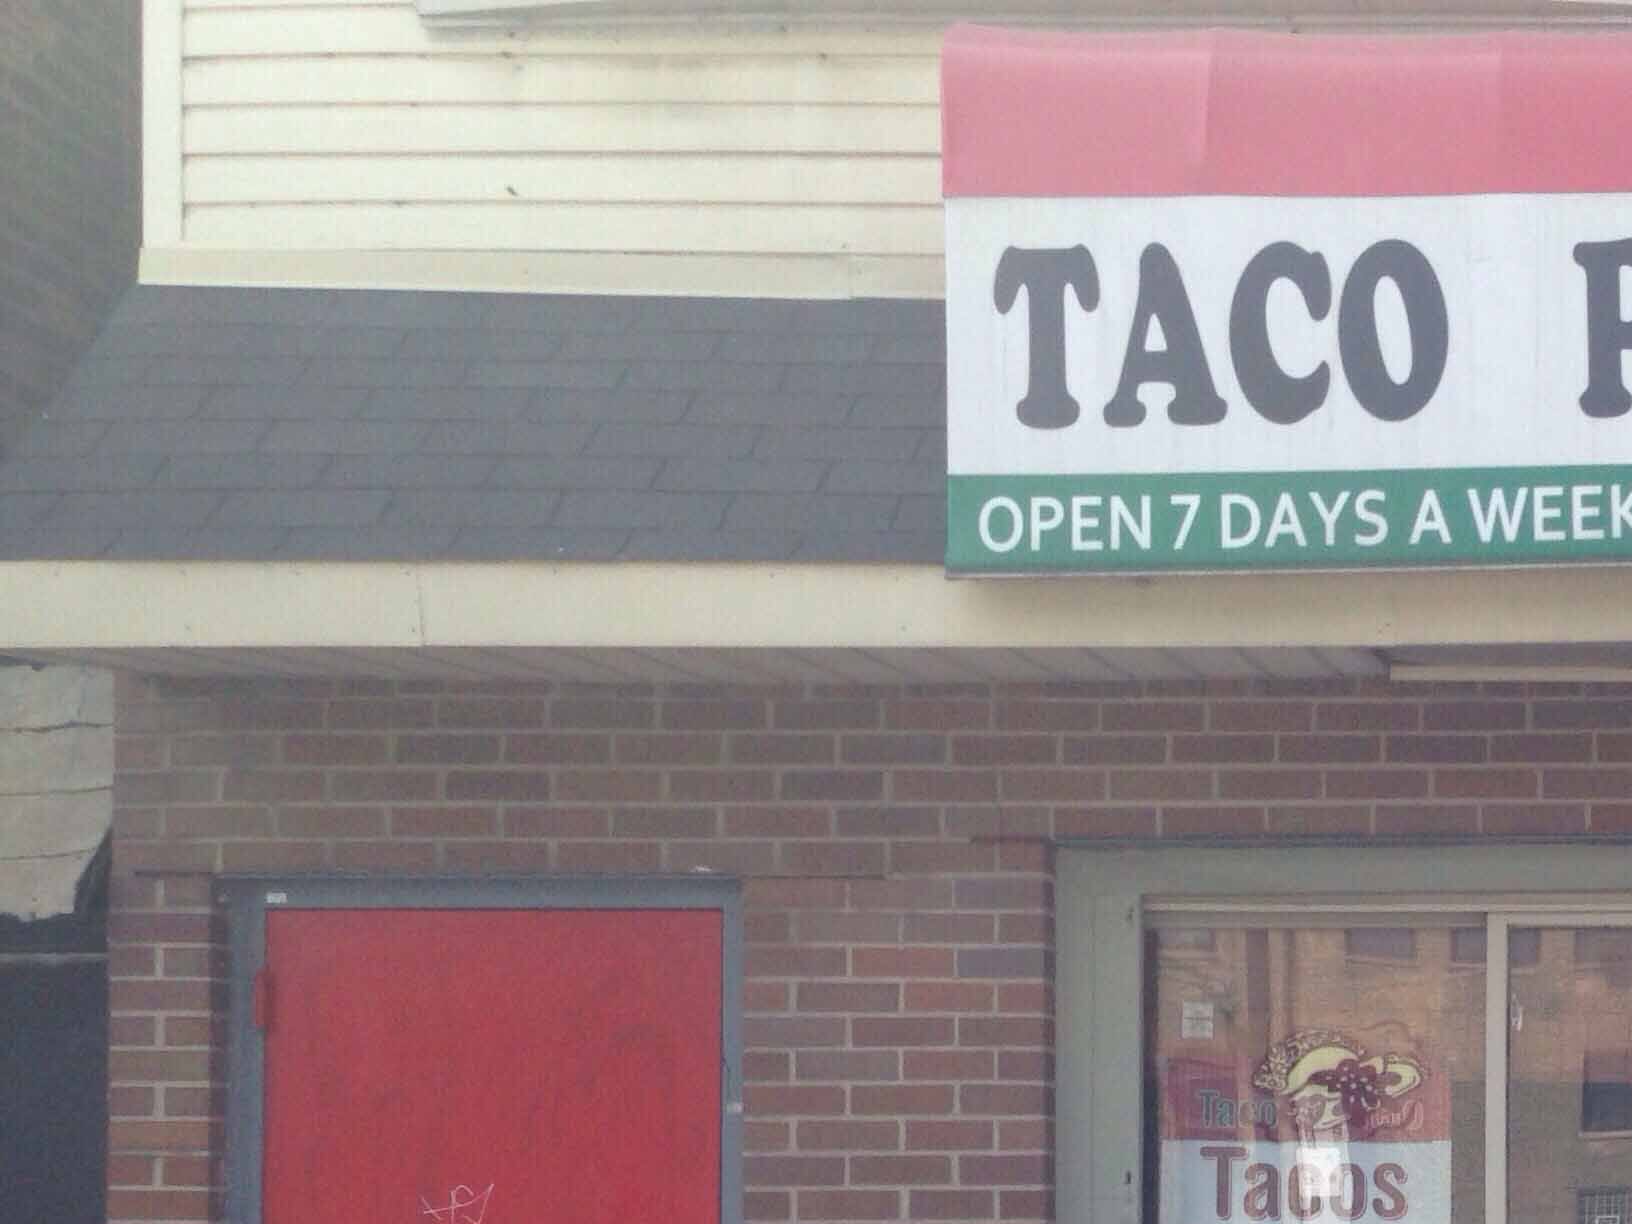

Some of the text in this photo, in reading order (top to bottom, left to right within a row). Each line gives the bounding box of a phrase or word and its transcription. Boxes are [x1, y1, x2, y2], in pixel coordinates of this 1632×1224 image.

[992, 238, 1449, 429] TACO
[978, 495, 1152, 552] OPEN
[1169, 495, 1201, 550] 7
[1220, 488, 1388, 549] DAYS
[1409, 488, 1452, 545] A
[1200, 1146, 1408, 1222] Tacos
